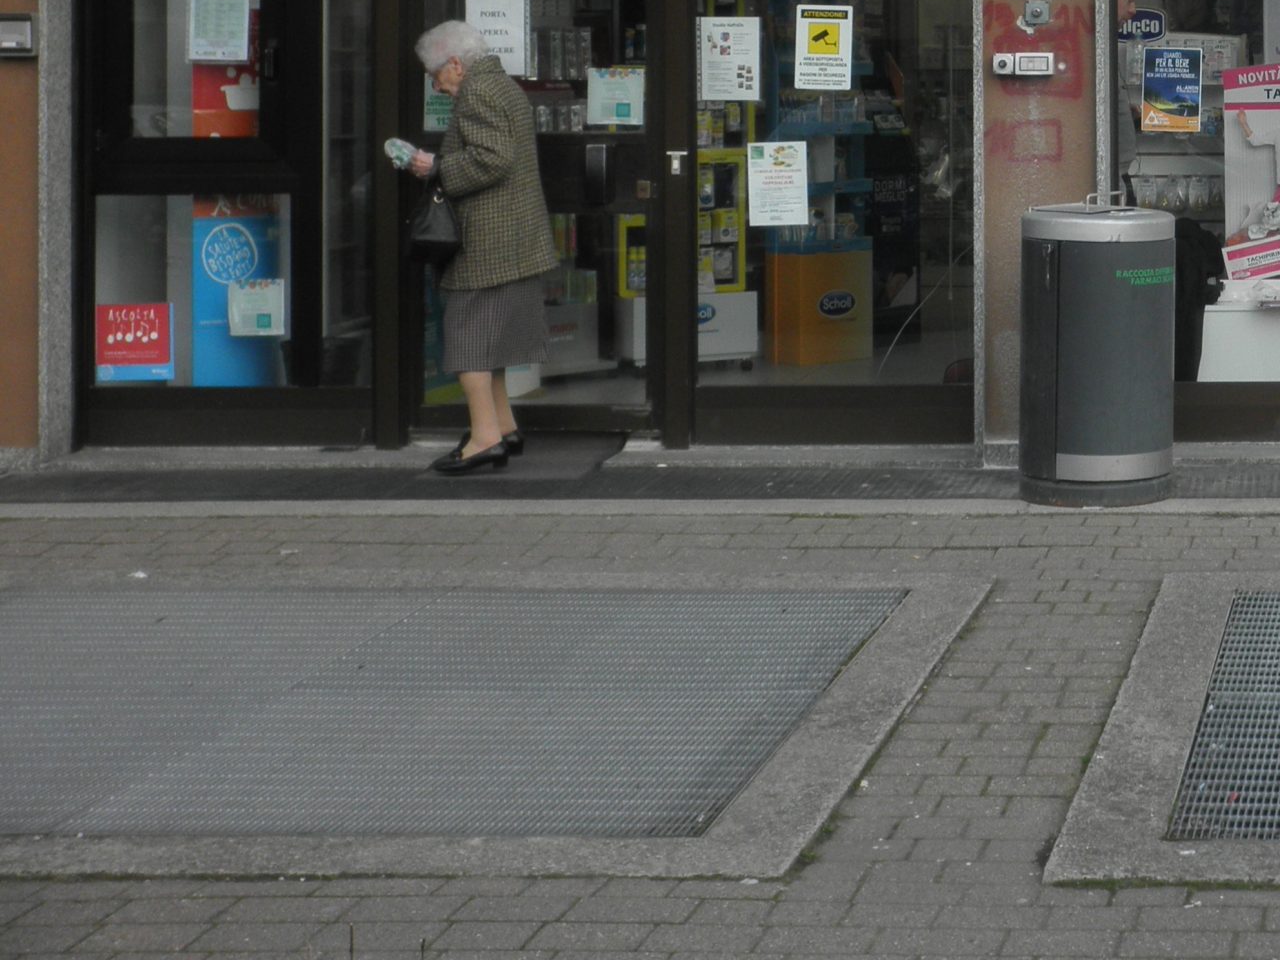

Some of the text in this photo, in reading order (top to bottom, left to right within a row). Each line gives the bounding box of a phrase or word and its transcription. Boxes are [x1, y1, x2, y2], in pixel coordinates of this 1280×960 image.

[803, 10, 846, 18] ATTENZIONE!
[1155, 58, 1167, 67] PER
[1175, 58, 1190, 68] BERE
[1115, 268, 1155, 278] RACCOLTA
[823, 295, 852, 310] Scholl
[108, 307, 155, 323] ASCOLTA
